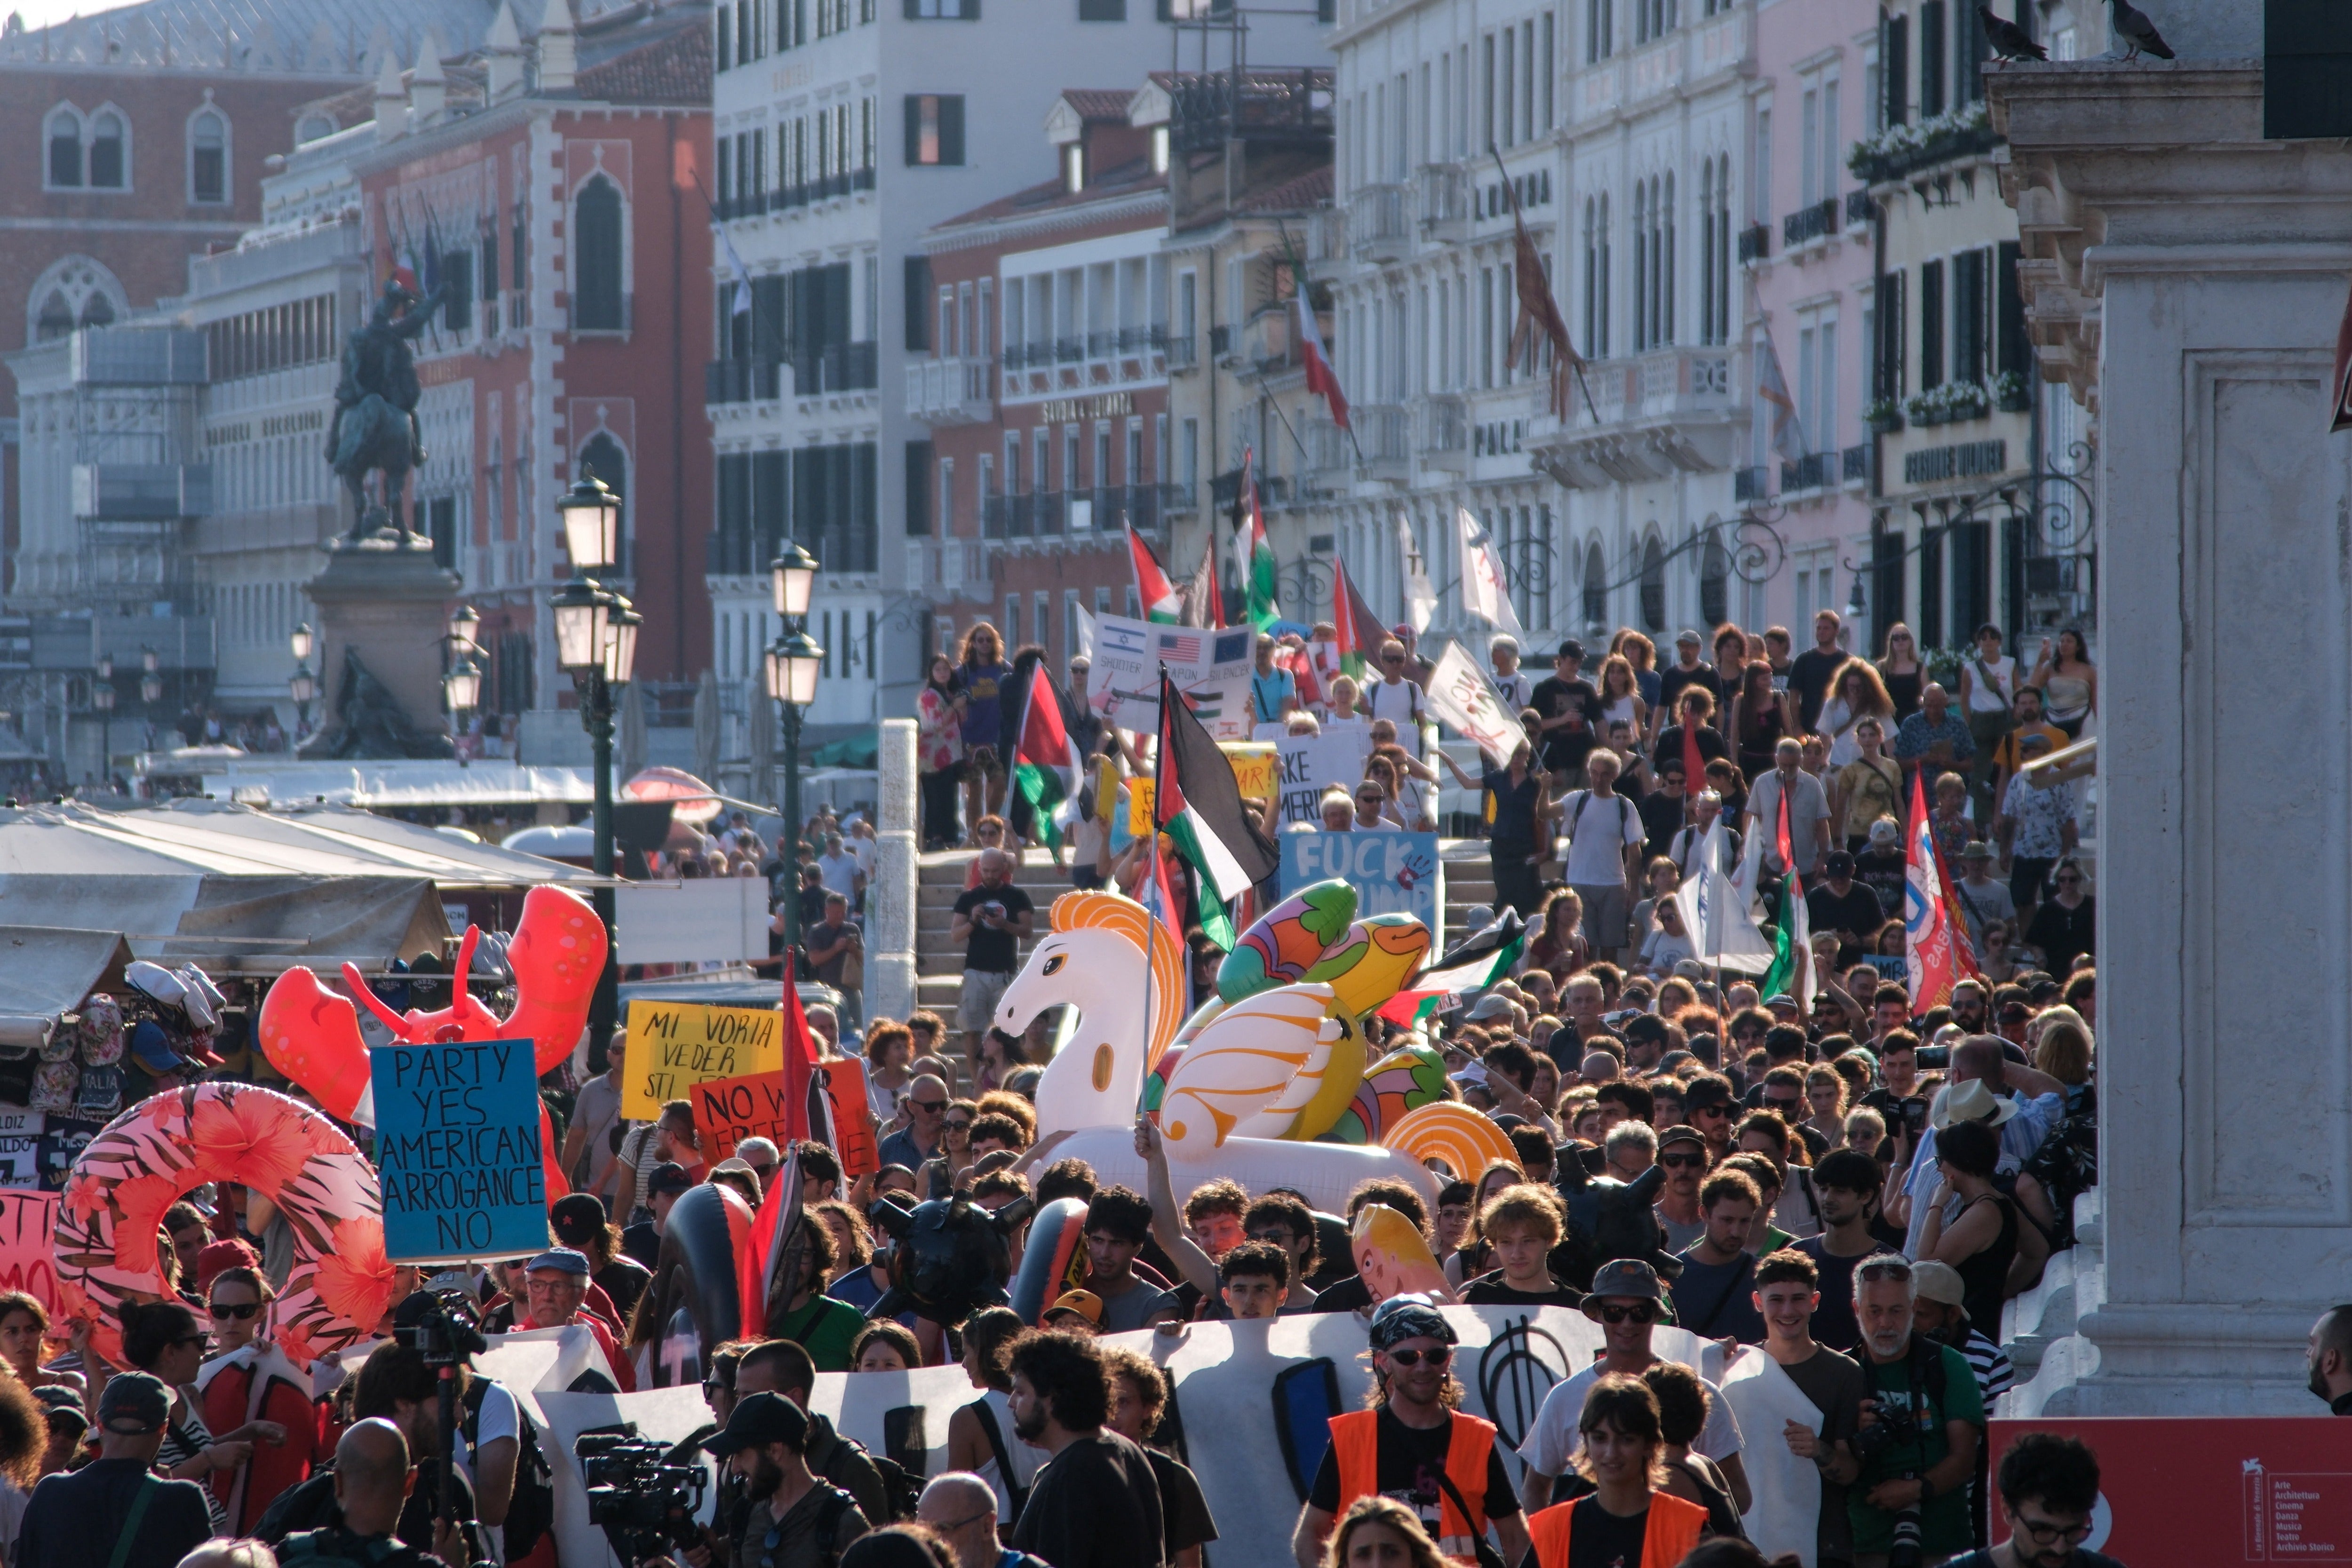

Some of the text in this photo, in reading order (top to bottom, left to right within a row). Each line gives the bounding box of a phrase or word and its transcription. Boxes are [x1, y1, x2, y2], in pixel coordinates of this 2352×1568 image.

[1101, 656, 1142, 674] SHOOTER
[1210, 664, 1250, 682] SILENCER
[1296, 835, 1414, 881] FUCK
[644, 1012, 774, 1048] MI VORIA
[395, 1046, 511, 1087] PARTY
[664, 1043, 735, 1073] VEDER
[644, 1073, 674, 1099] STI
[702, 1069, 841, 1127] NO WR
[414, 1087, 487, 1127] YES
[381, 1130, 541, 1171] AMERICAN
[383, 1165, 544, 1212] ARROGANCE
[437, 1210, 493, 1250] NO
[2275, 1491, 2320, 1499] Architettura
